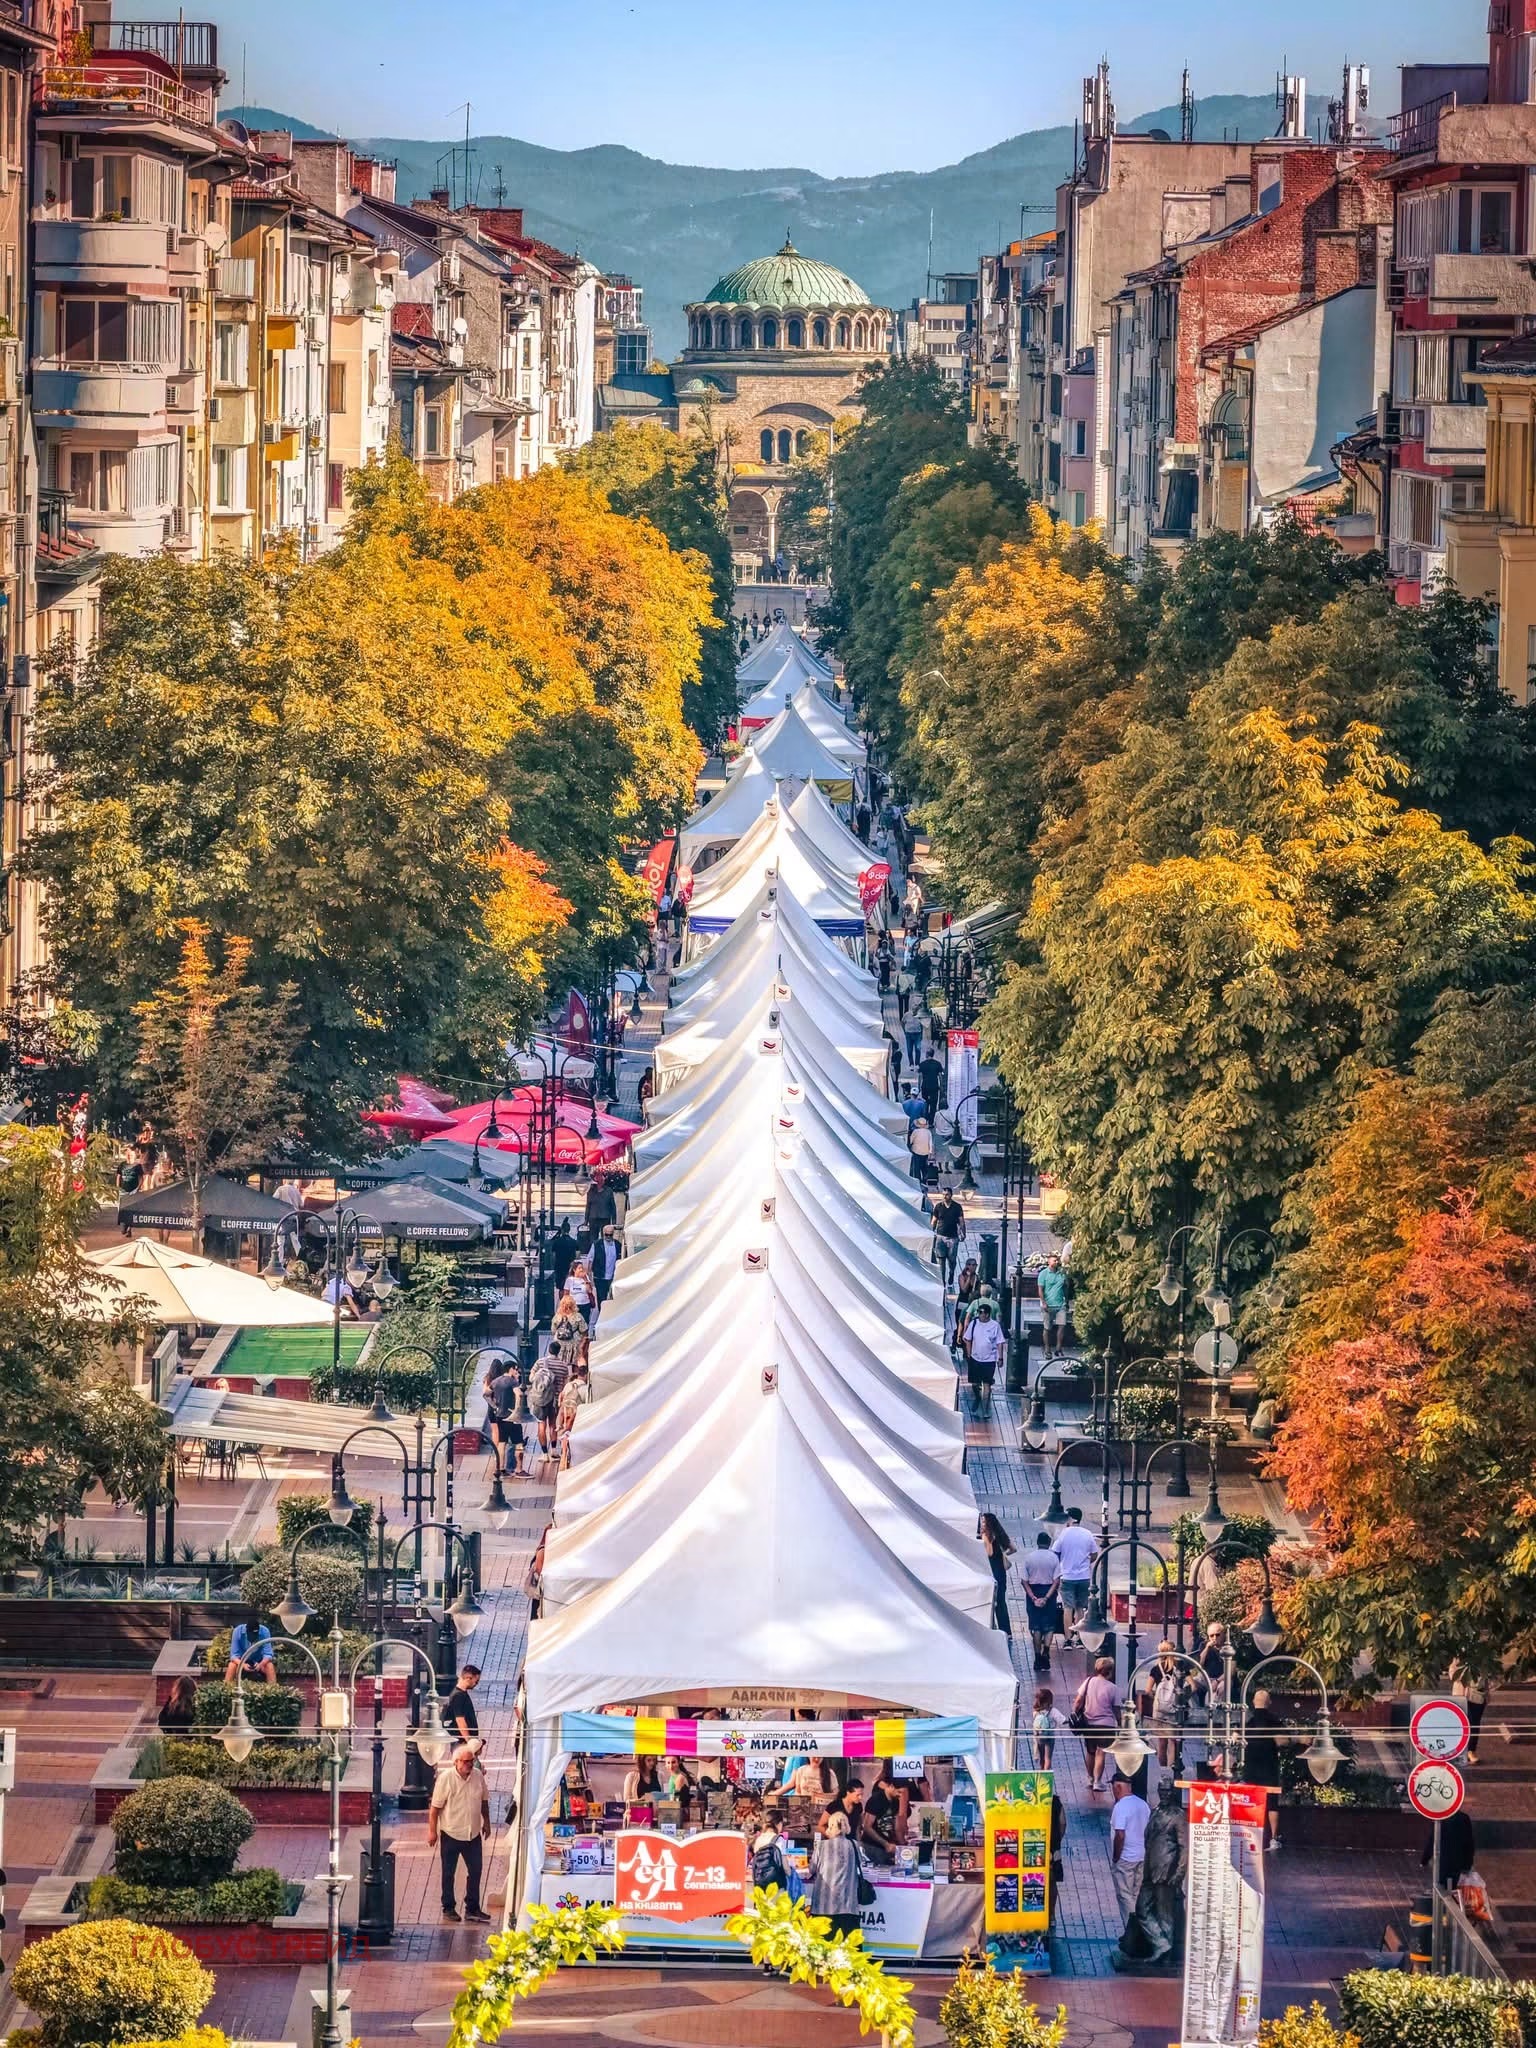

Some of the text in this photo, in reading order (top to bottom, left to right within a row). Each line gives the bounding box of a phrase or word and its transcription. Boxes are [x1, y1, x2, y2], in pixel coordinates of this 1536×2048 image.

[300, 1168, 330, 1177] FELLOWS
[351, 1180, 376, 1189] COFFEE
[138, 1215, 164, 1224] COFFEE
[226, 1220, 252, 1229] COFFEE
[351, 1225, 382, 1234] FLLOWS
[412, 1226, 469, 1237] COFFEE FELLOWS
[750, 1739, 819, 1751] МИРАНДА
[894, 1760, 922, 1770] КАСА
[683, 1881, 742, 1891] септември
[619, 1902, 683, 1911] на книгата
